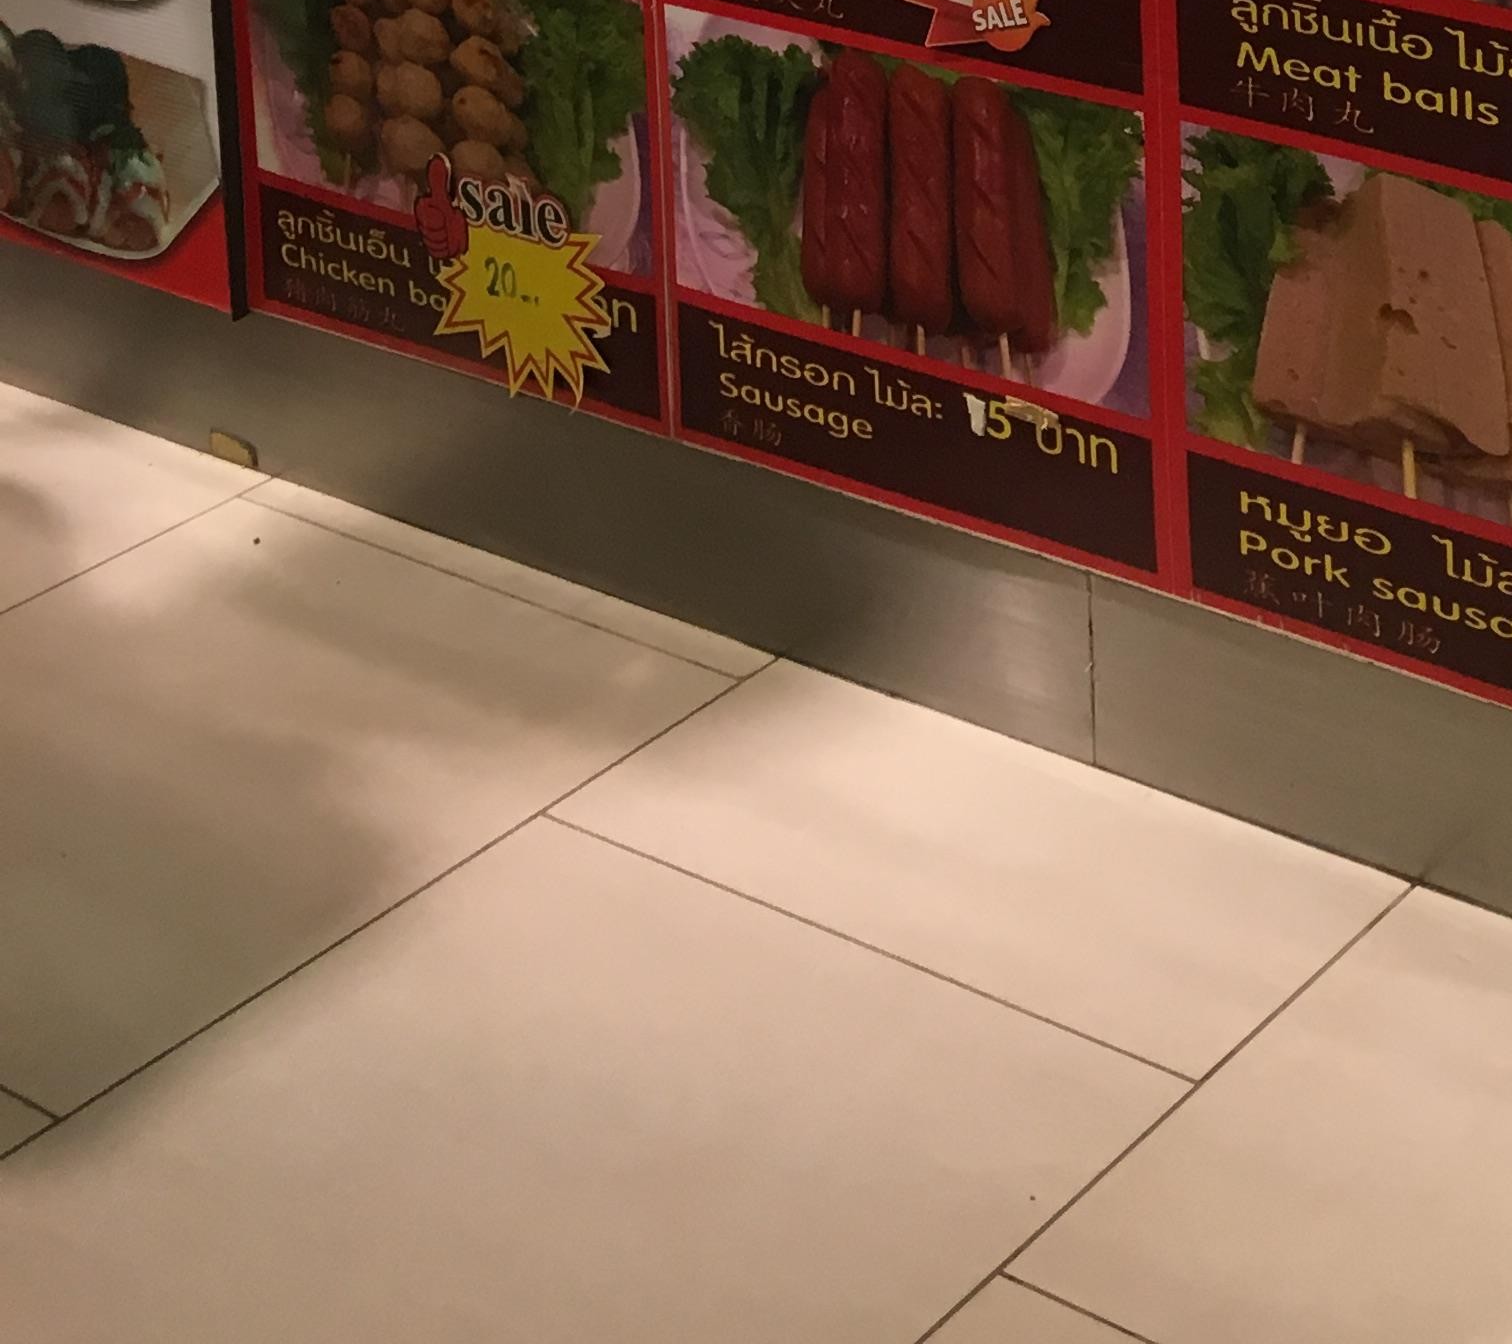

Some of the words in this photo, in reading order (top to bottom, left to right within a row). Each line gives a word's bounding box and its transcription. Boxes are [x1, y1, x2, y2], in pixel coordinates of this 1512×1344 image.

[1235, 41, 1363, 93] Meat
[1382, 70, 1501, 127] balls
[456, 170, 569, 249] sale
[280, 242, 397, 298] Chicken
[708, 319, 858, 396] ไส้กรอก
[865, 364, 944, 421] ไม้ละ
[1034, 418, 1121, 476] บาท
[719, 372, 876, 442] Sausage
[1239, 489, 1393, 556] หมูยอ
[1239, 530, 1351, 589] Pork
